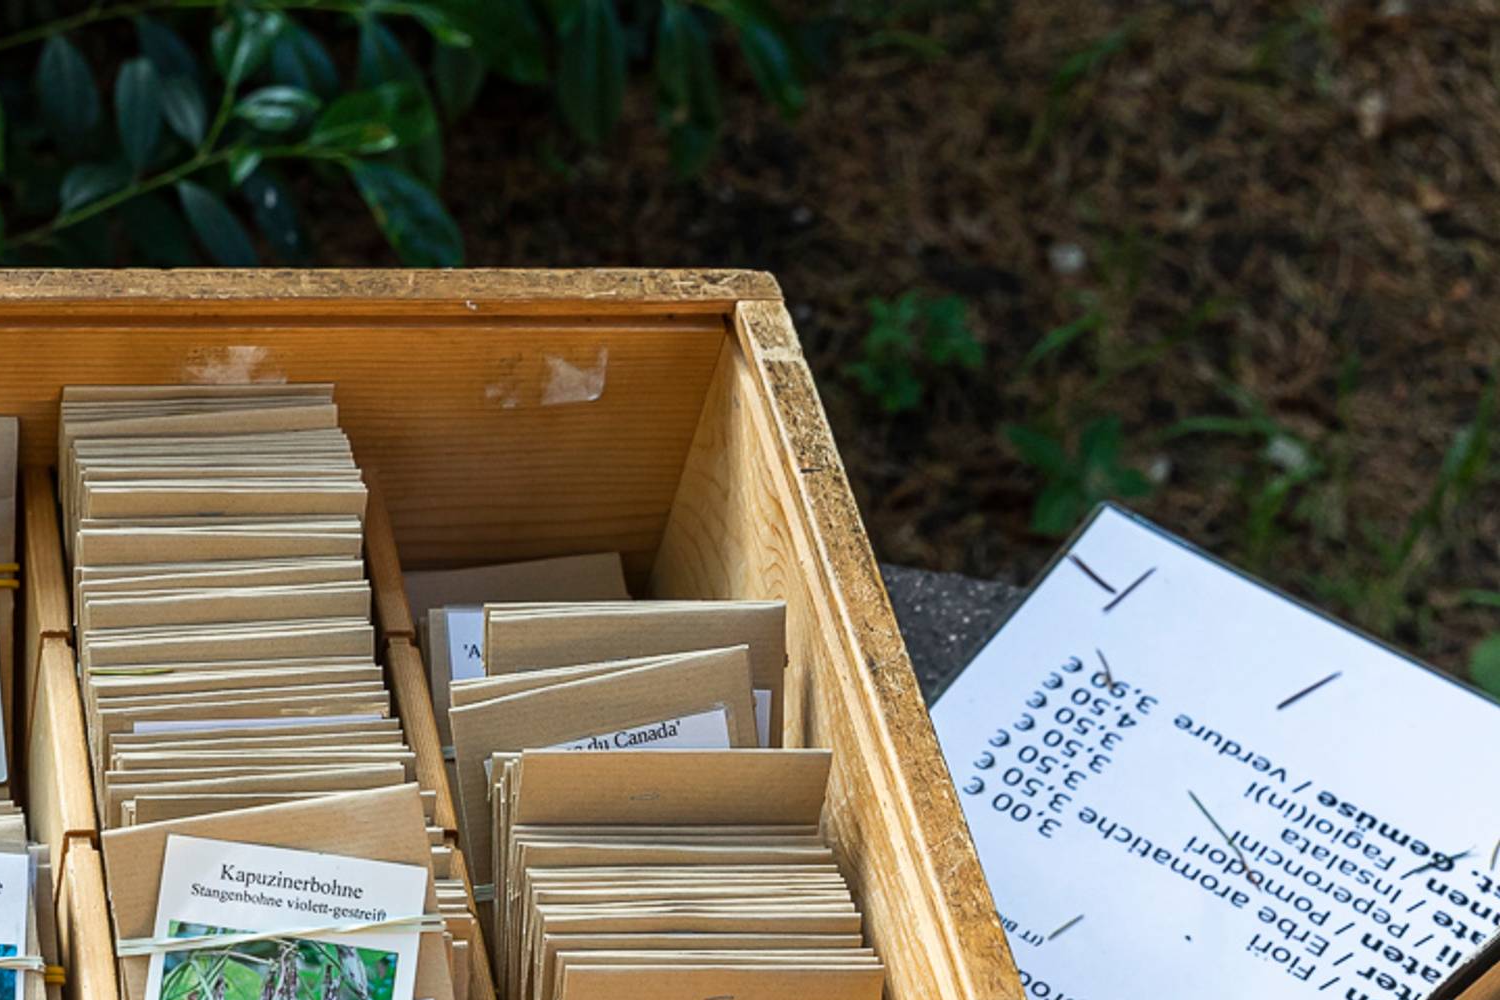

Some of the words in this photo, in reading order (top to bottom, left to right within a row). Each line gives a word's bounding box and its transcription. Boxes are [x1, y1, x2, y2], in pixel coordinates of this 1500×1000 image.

[1054, 706, 1124, 752] 3,50
[1070, 687, 1138, 729] 4,50
[1017, 745, 1088, 791] 3,50
[1042, 728, 1113, 775] 3,50
[1172, 713, 1288, 783] verdure
[1002, 766, 1073, 814] 3,50
[991, 792, 1063, 839] 3,00
[219, 863, 364, 900] Kapuzinerbohne
[1077, 806, 1251, 909] aromatiche
[1185, 835, 1333, 928] Pomodori
[1280, 827, 1403, 905] Insalata
[190, 882, 284, 909] Stangenbohne
[1230, 829, 1411, 940] Peperoncini
[1256, 904, 1332, 959] Erbe
[1245, 933, 1317, 984] Fiori
